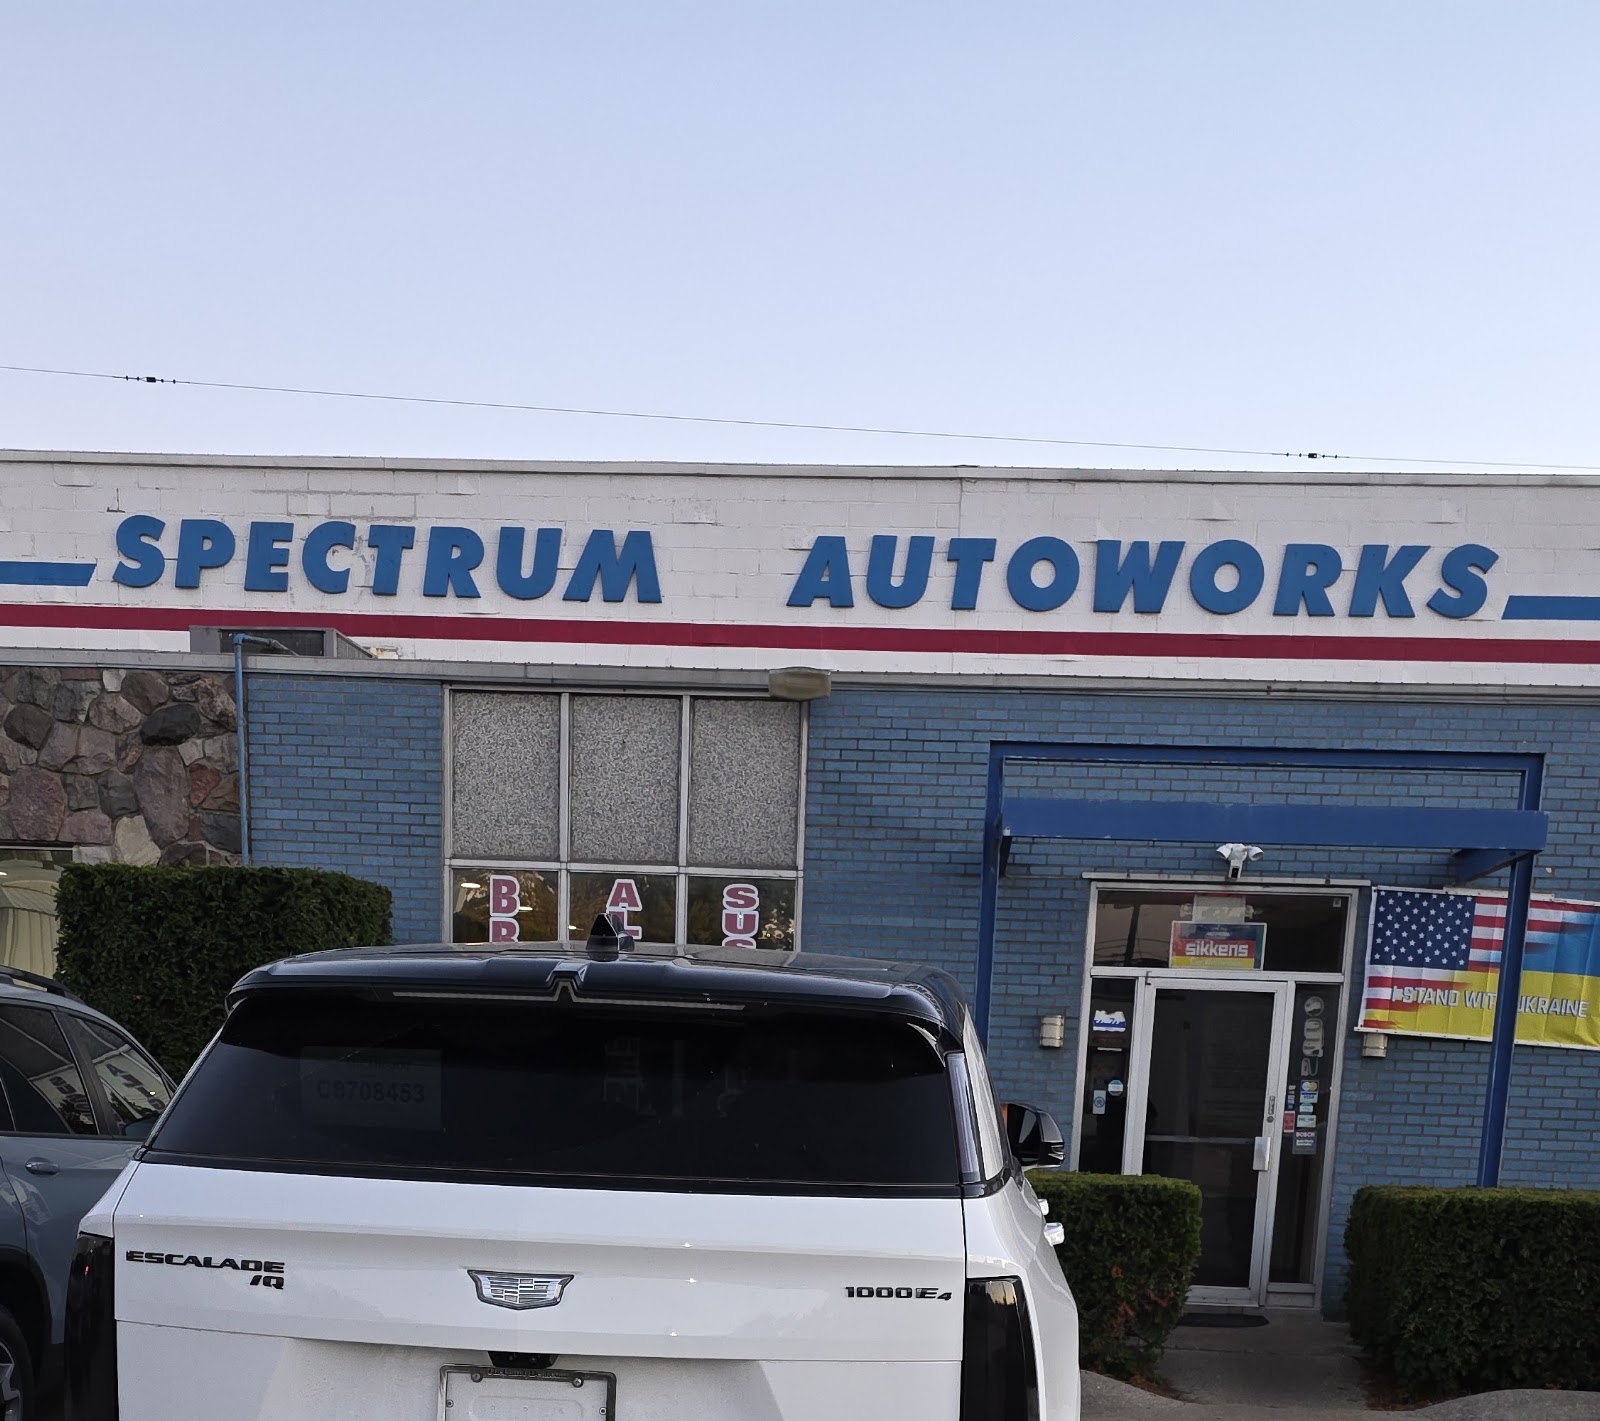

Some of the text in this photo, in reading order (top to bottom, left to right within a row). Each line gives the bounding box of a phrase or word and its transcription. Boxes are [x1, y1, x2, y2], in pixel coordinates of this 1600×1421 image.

[112, 514, 1499, 620] SPECTRUM AUTOWORKS
[1185, 940, 1249, 957] sikkens
[1402, 987, 1460, 1008] STAND
[1464, 990, 1498, 1010] WIT
[126, 1250, 285, 1273] ESCALADE
[250, 1275, 285, 1290] IQ
[845, 1286, 952, 1301] 1000E4
